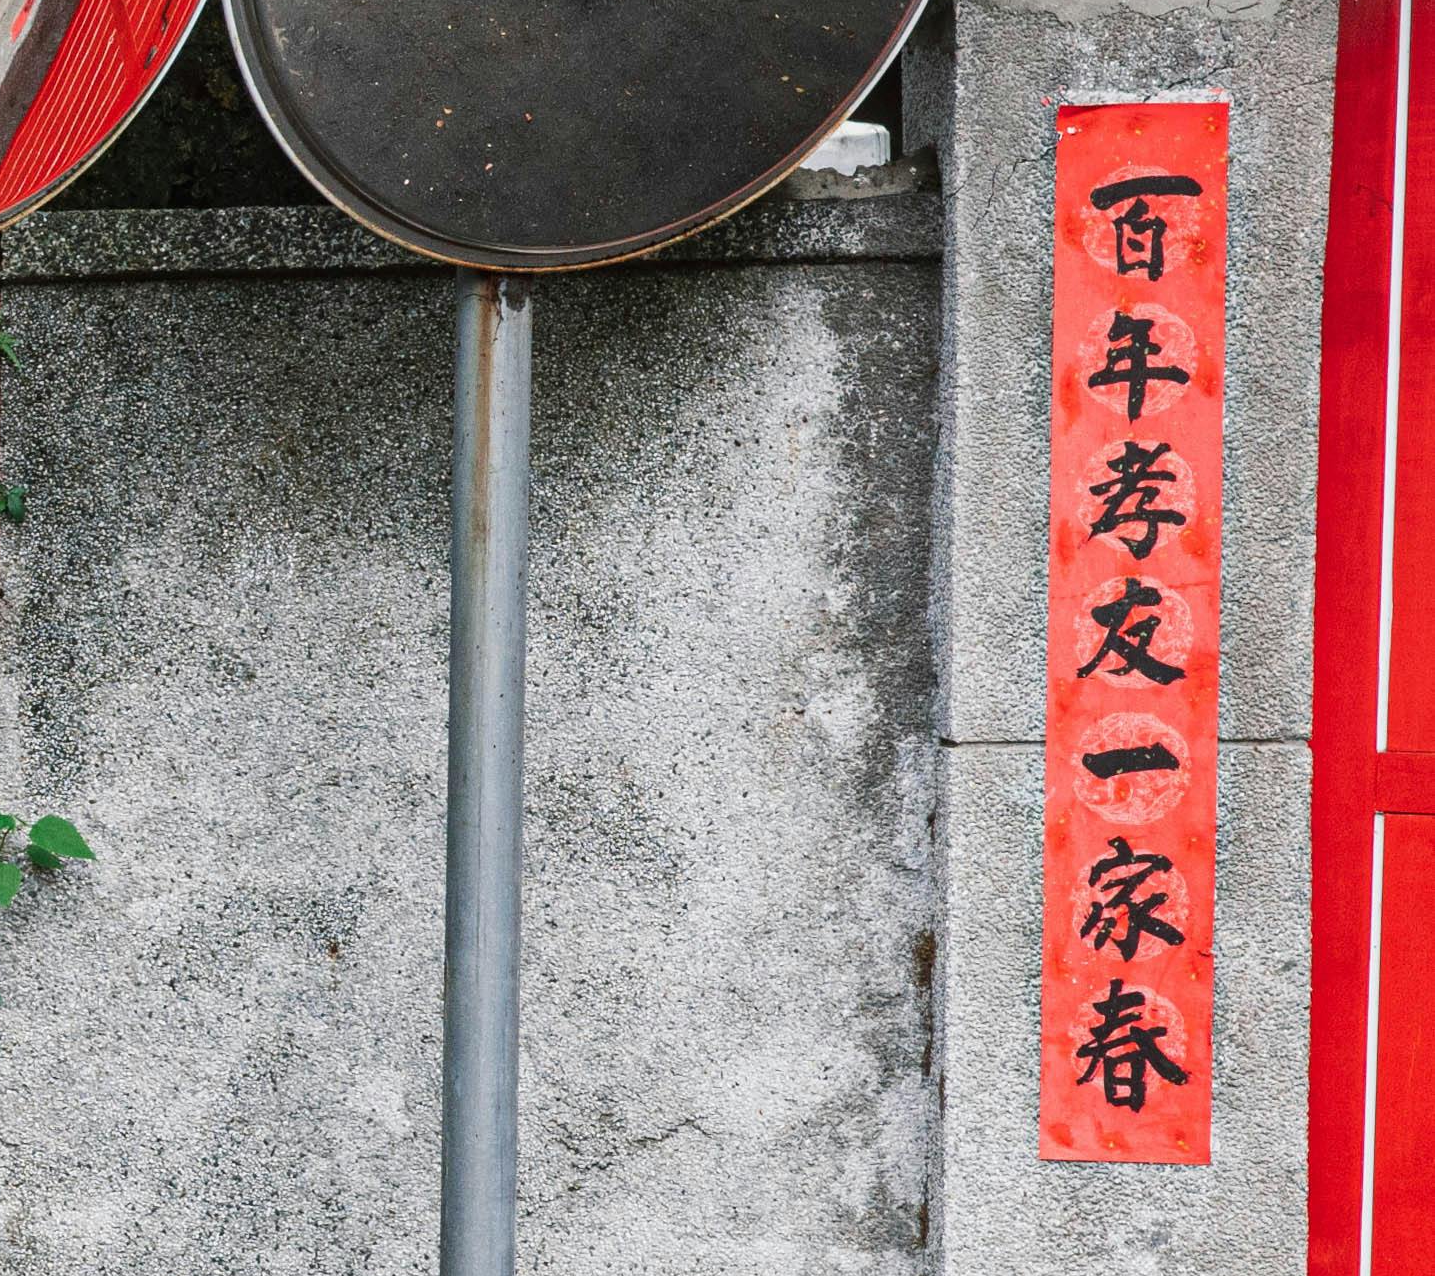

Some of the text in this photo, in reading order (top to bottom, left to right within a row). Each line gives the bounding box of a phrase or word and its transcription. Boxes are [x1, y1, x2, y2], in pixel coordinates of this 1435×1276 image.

[1076, 175, 1203, 1113] 百年孝友一家春
